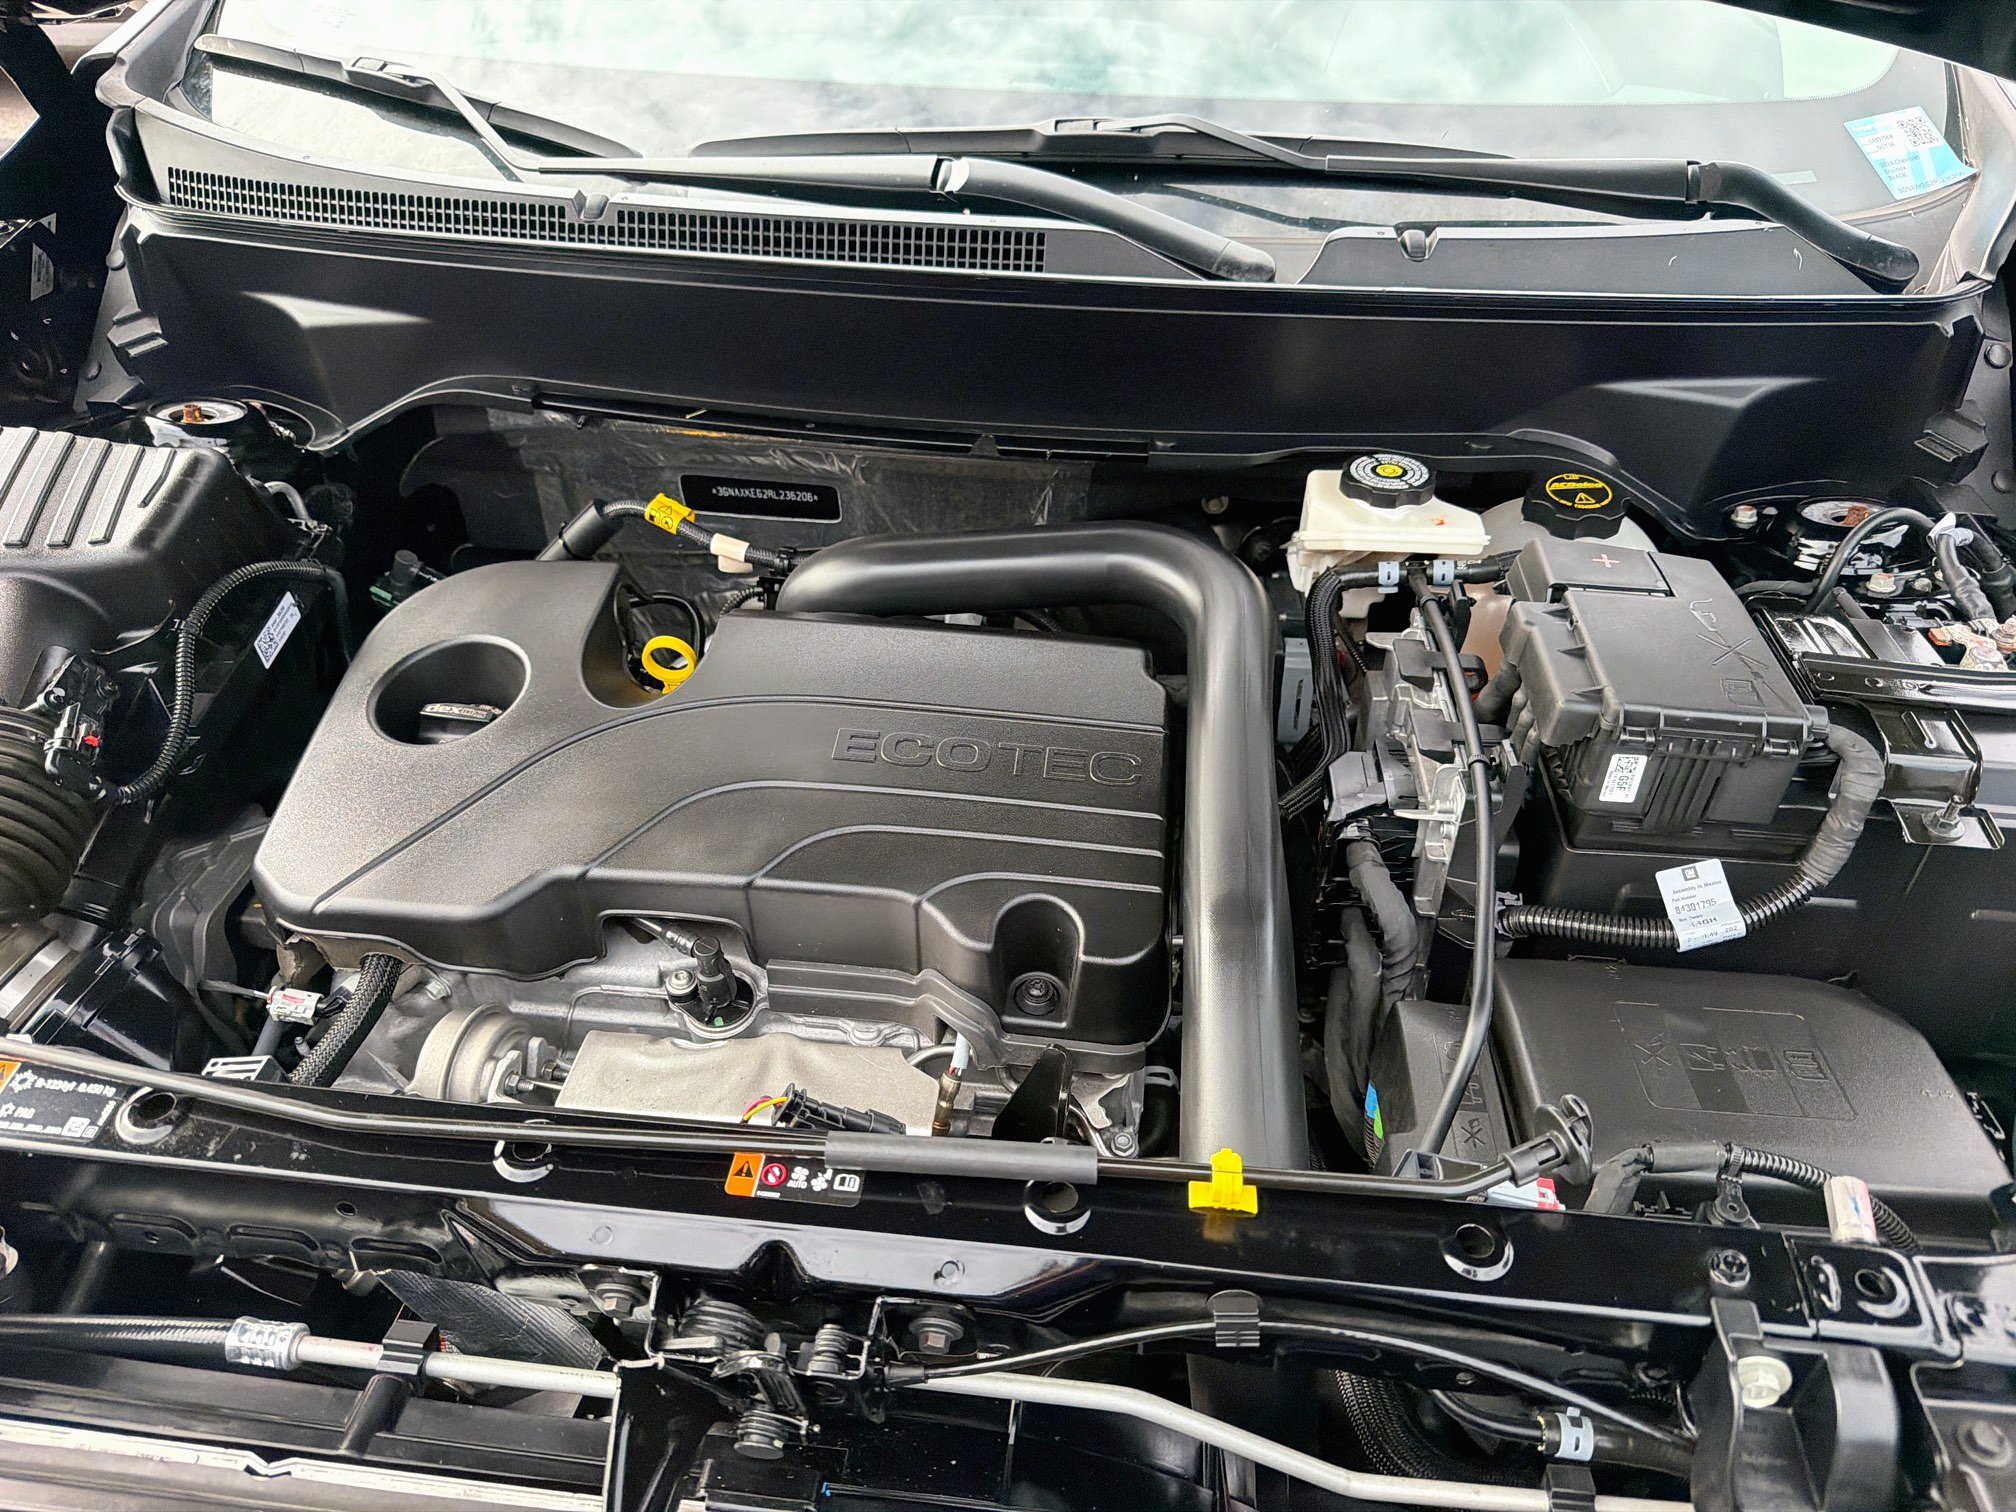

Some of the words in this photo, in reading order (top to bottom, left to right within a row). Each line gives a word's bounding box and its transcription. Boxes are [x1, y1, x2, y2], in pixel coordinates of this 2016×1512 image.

[831, 727, 1142, 787] ECOTEC
[1616, 775, 1630, 792] G5F
[1672, 886, 1697, 895] Assembly
[1703, 879, 1722, 888] Mexico
[786, 1179, 807, 1189] AUTO
